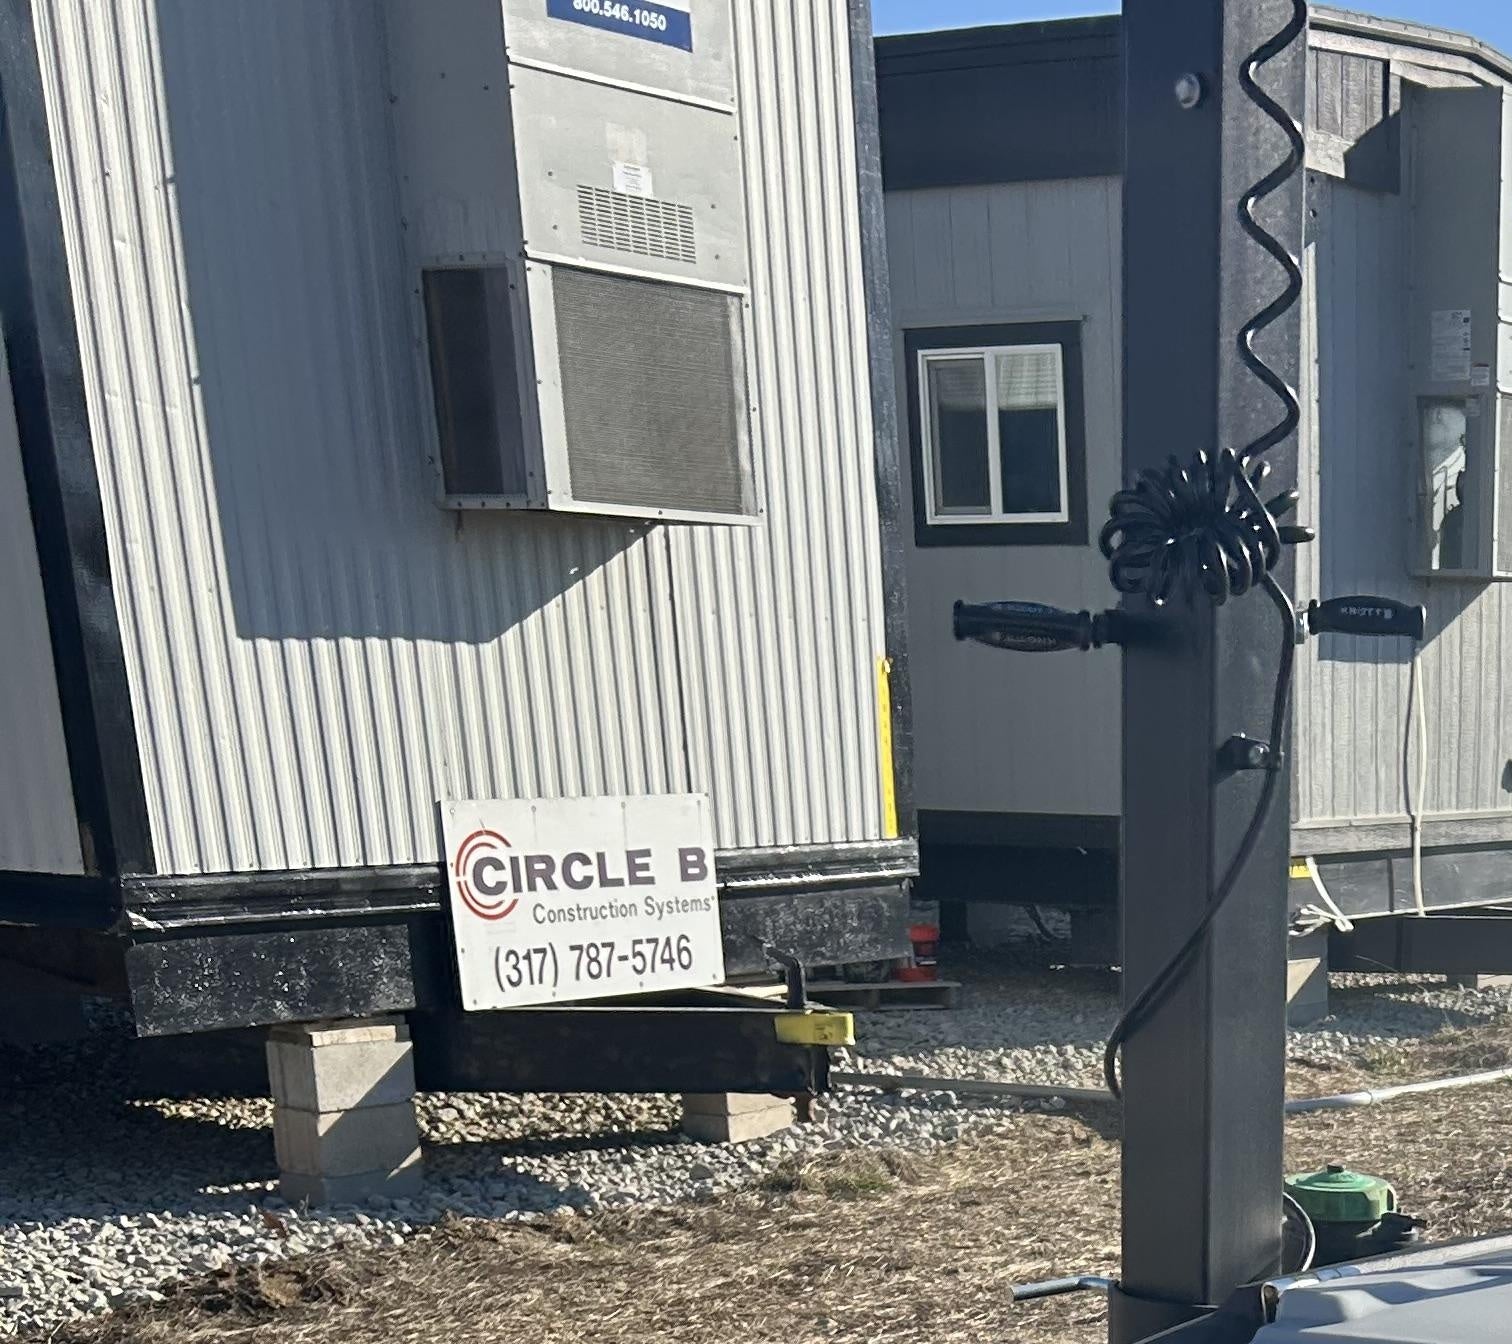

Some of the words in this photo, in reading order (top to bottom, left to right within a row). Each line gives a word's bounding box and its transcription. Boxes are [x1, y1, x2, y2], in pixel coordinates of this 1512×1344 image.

[473, 848, 655, 895] CIRCLE
[679, 847, 708, 882] B
[532, 898, 638, 925] Construction
[644, 894, 713, 917] Systems
[494, 942, 559, 992] (317)
[569, 934, 693, 981] 787-5746
